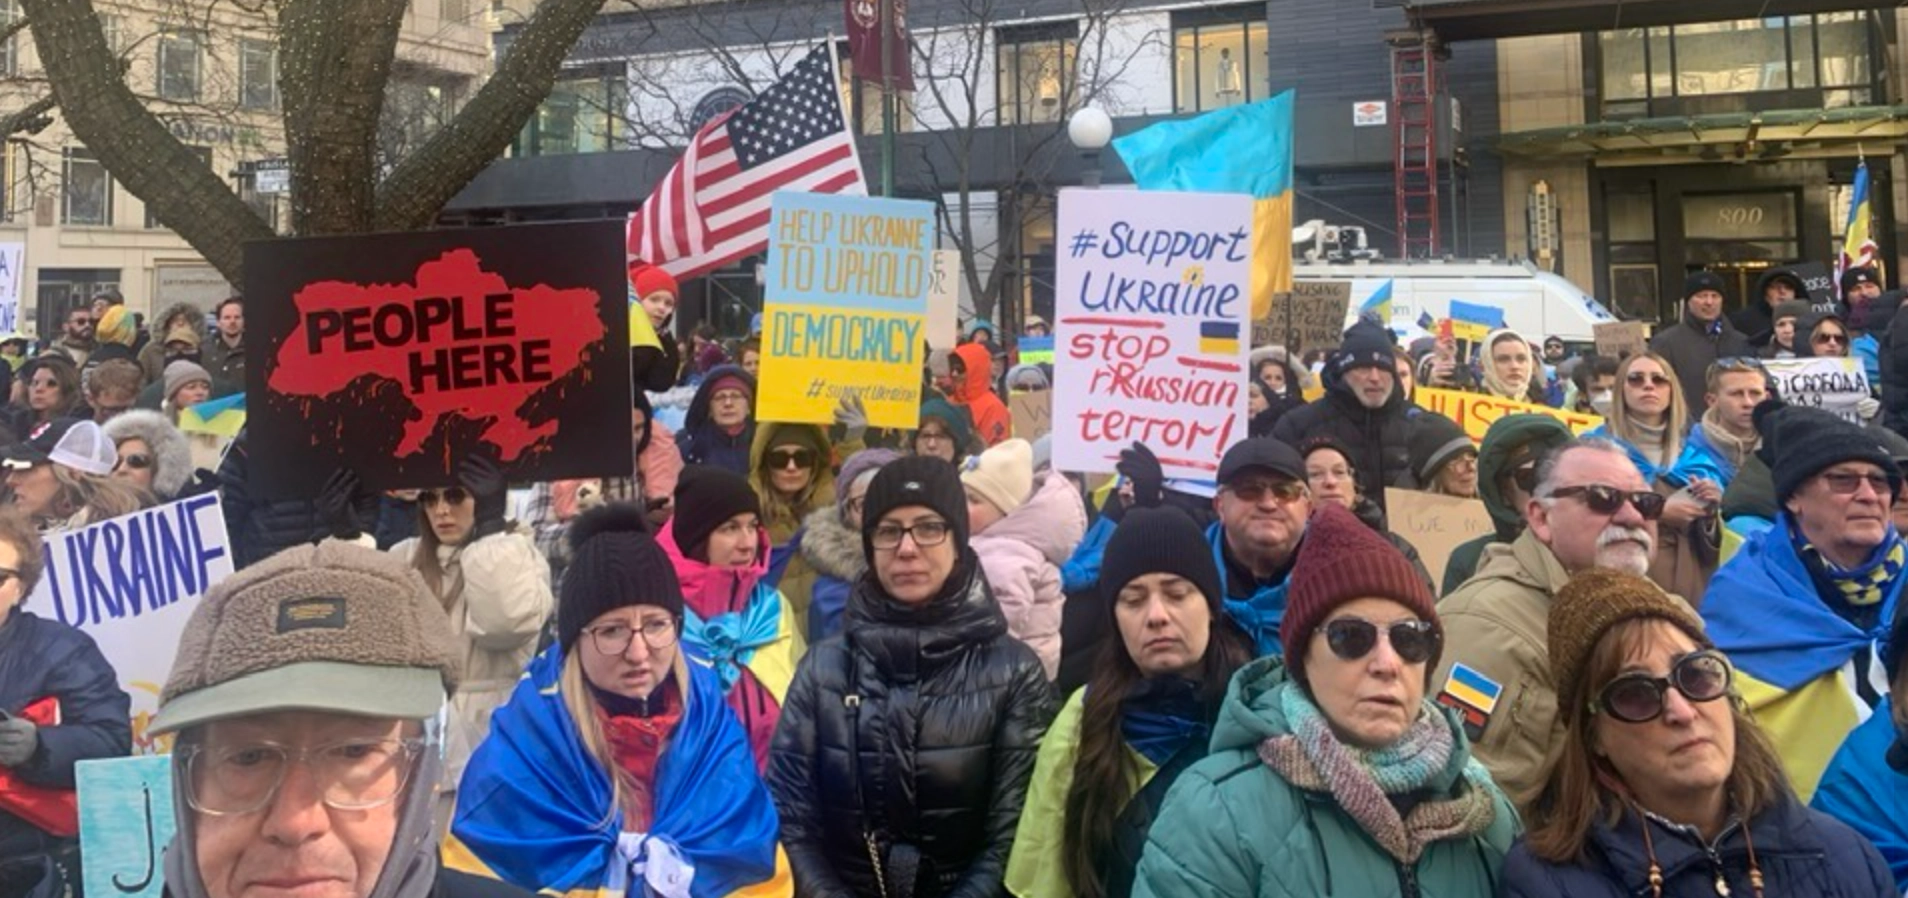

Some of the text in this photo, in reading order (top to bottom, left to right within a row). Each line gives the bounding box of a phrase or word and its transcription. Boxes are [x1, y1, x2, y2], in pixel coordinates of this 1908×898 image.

[780, 209, 927, 250] HELP UKRAINE
[1717, 206, 1763, 226] 800
[1068, 221, 1249, 267] #Support
[778, 243, 924, 299] TO UPHOLD
[305, 293, 516, 355] PEOPLE
[771, 311, 921, 364] DEMOCRACY
[1069, 327, 1171, 364] stop
[408, 339, 553, 395] HERE
[1077, 408, 1236, 460] terror!
